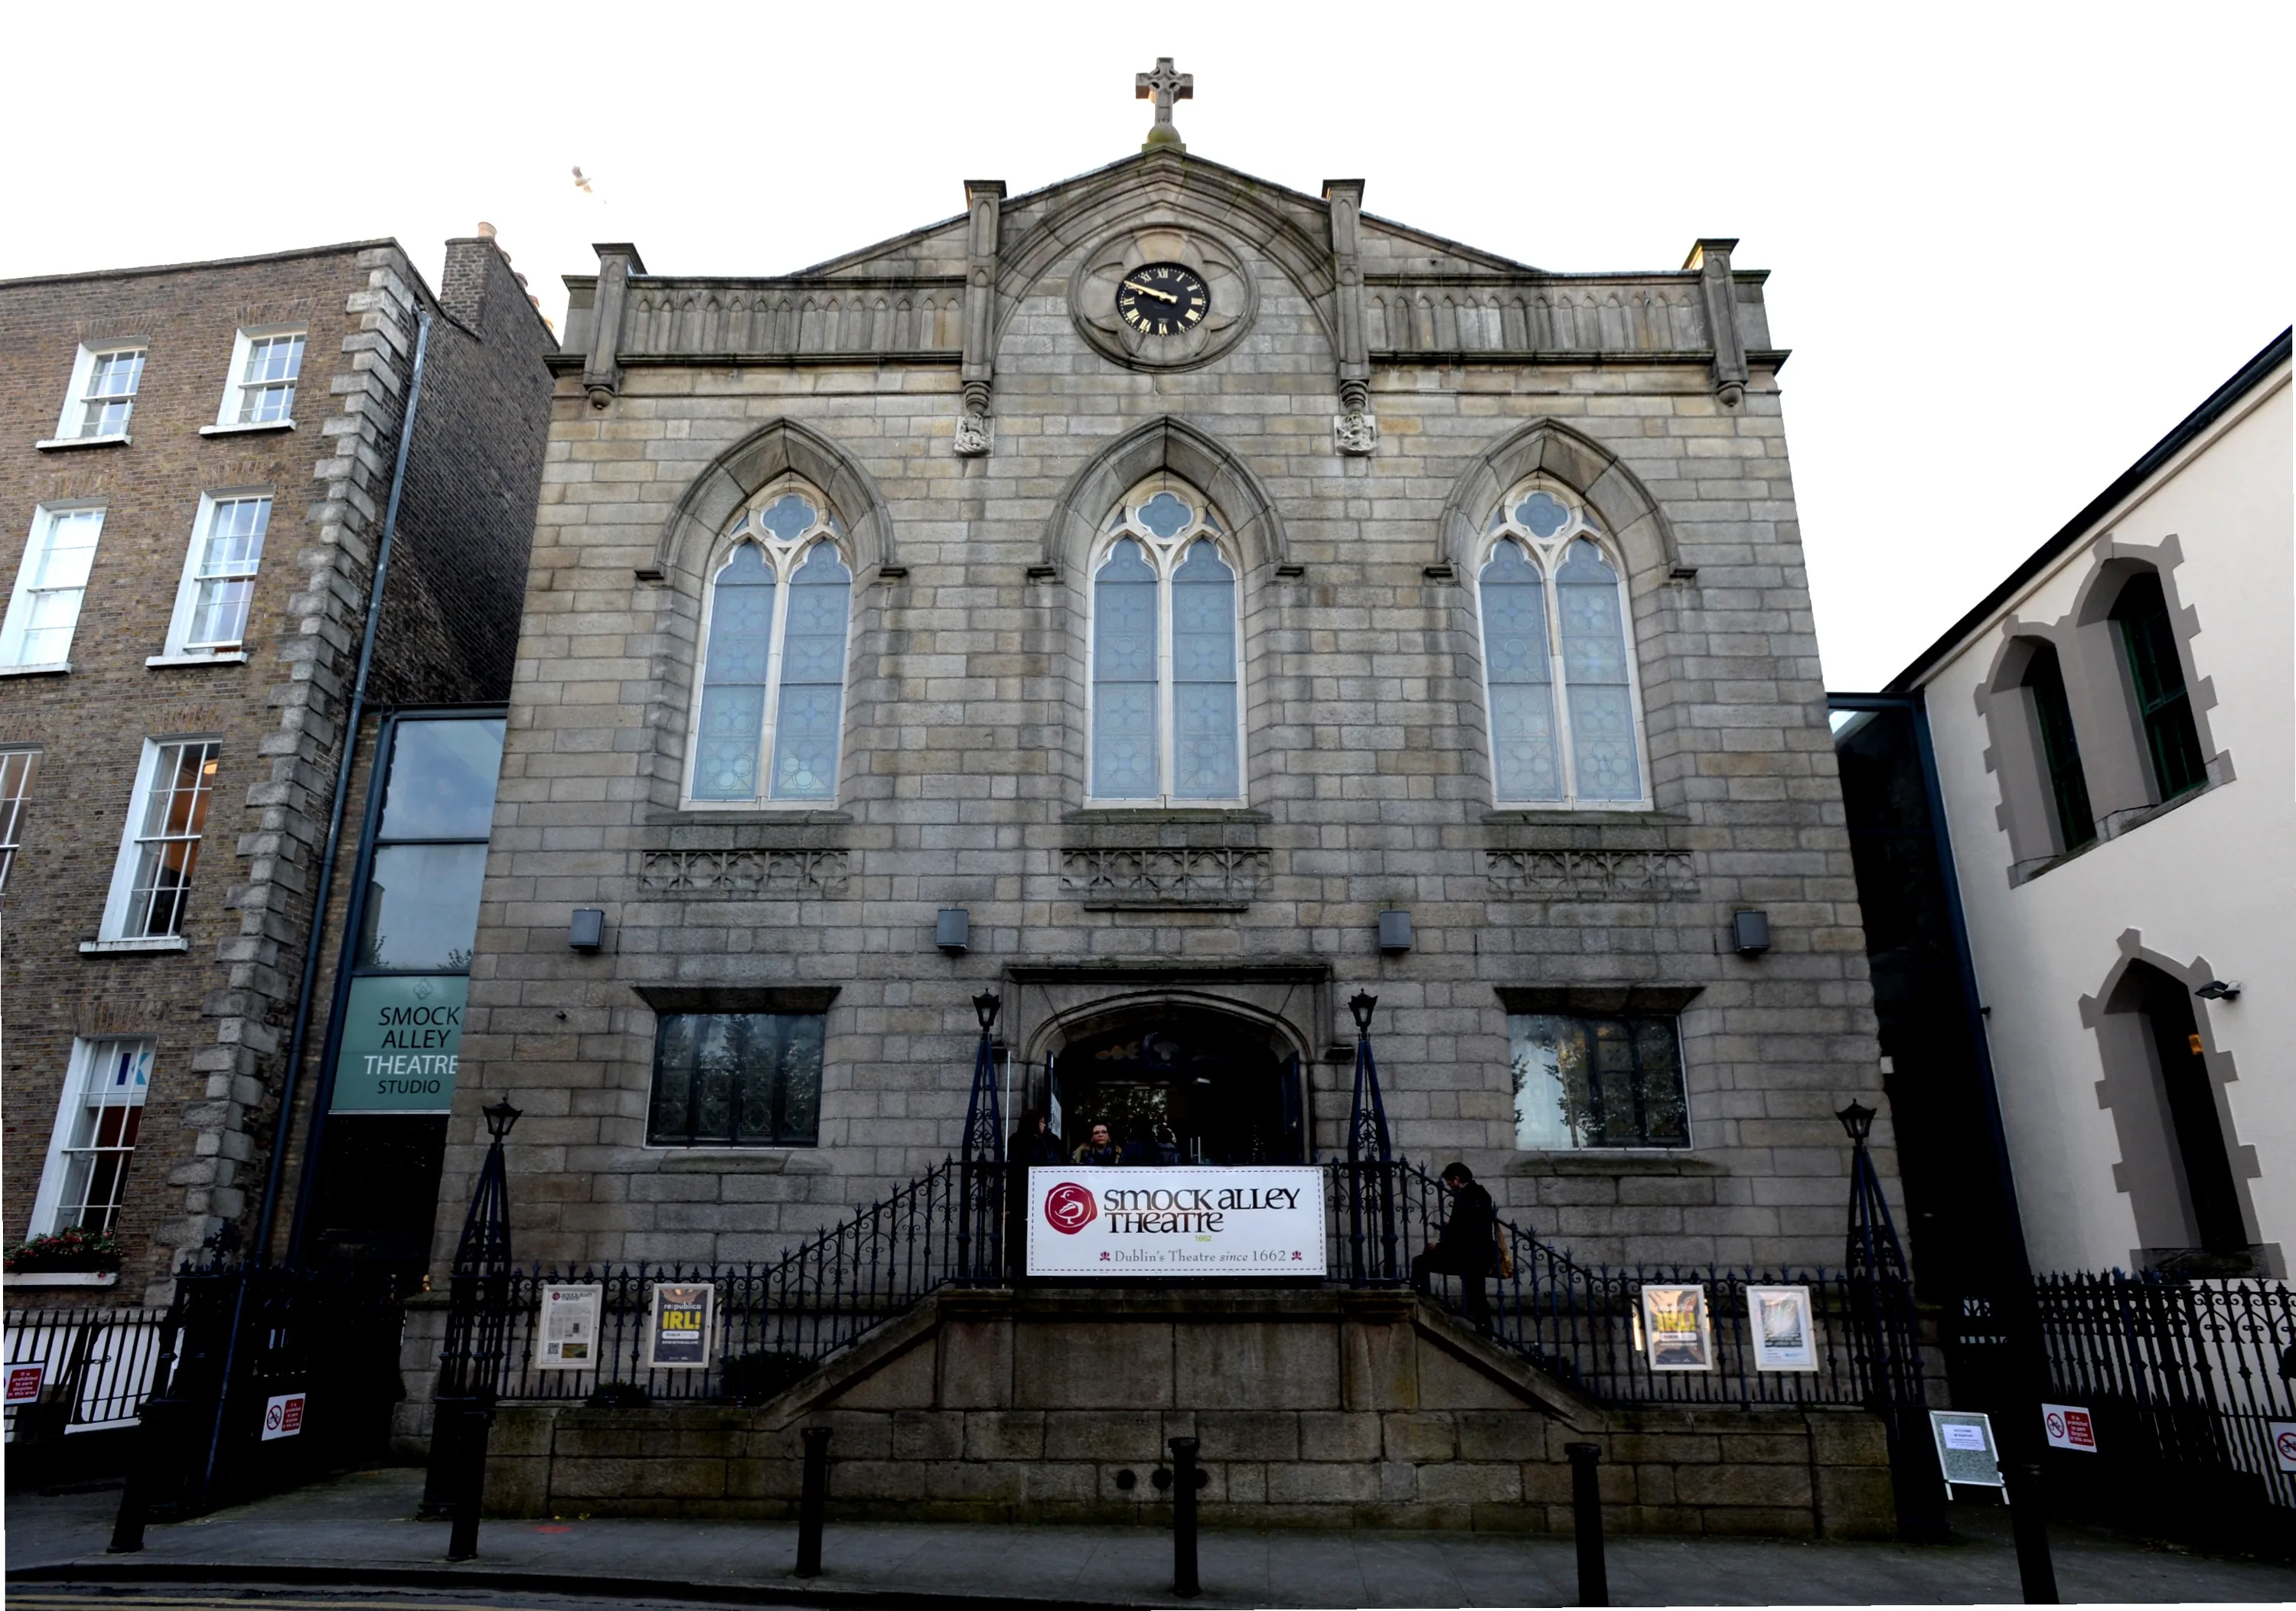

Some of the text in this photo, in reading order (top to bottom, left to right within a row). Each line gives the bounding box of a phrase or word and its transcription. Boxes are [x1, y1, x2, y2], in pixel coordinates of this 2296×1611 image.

[1157, 269, 1168, 279] XII
[378, 1006, 461, 1026] SMOCK
[381, 1029, 451, 1048] ALLEY
[364, 1055, 459, 1075] THEATRE
[377, 1079, 441, 1094] STUDIO
[1115, 1249, 1287, 1262] Dublin's Theatre since 1662
[662, 1310, 702, 1329] IRL!
[1656, 1311, 1696, 1332] IRL!
